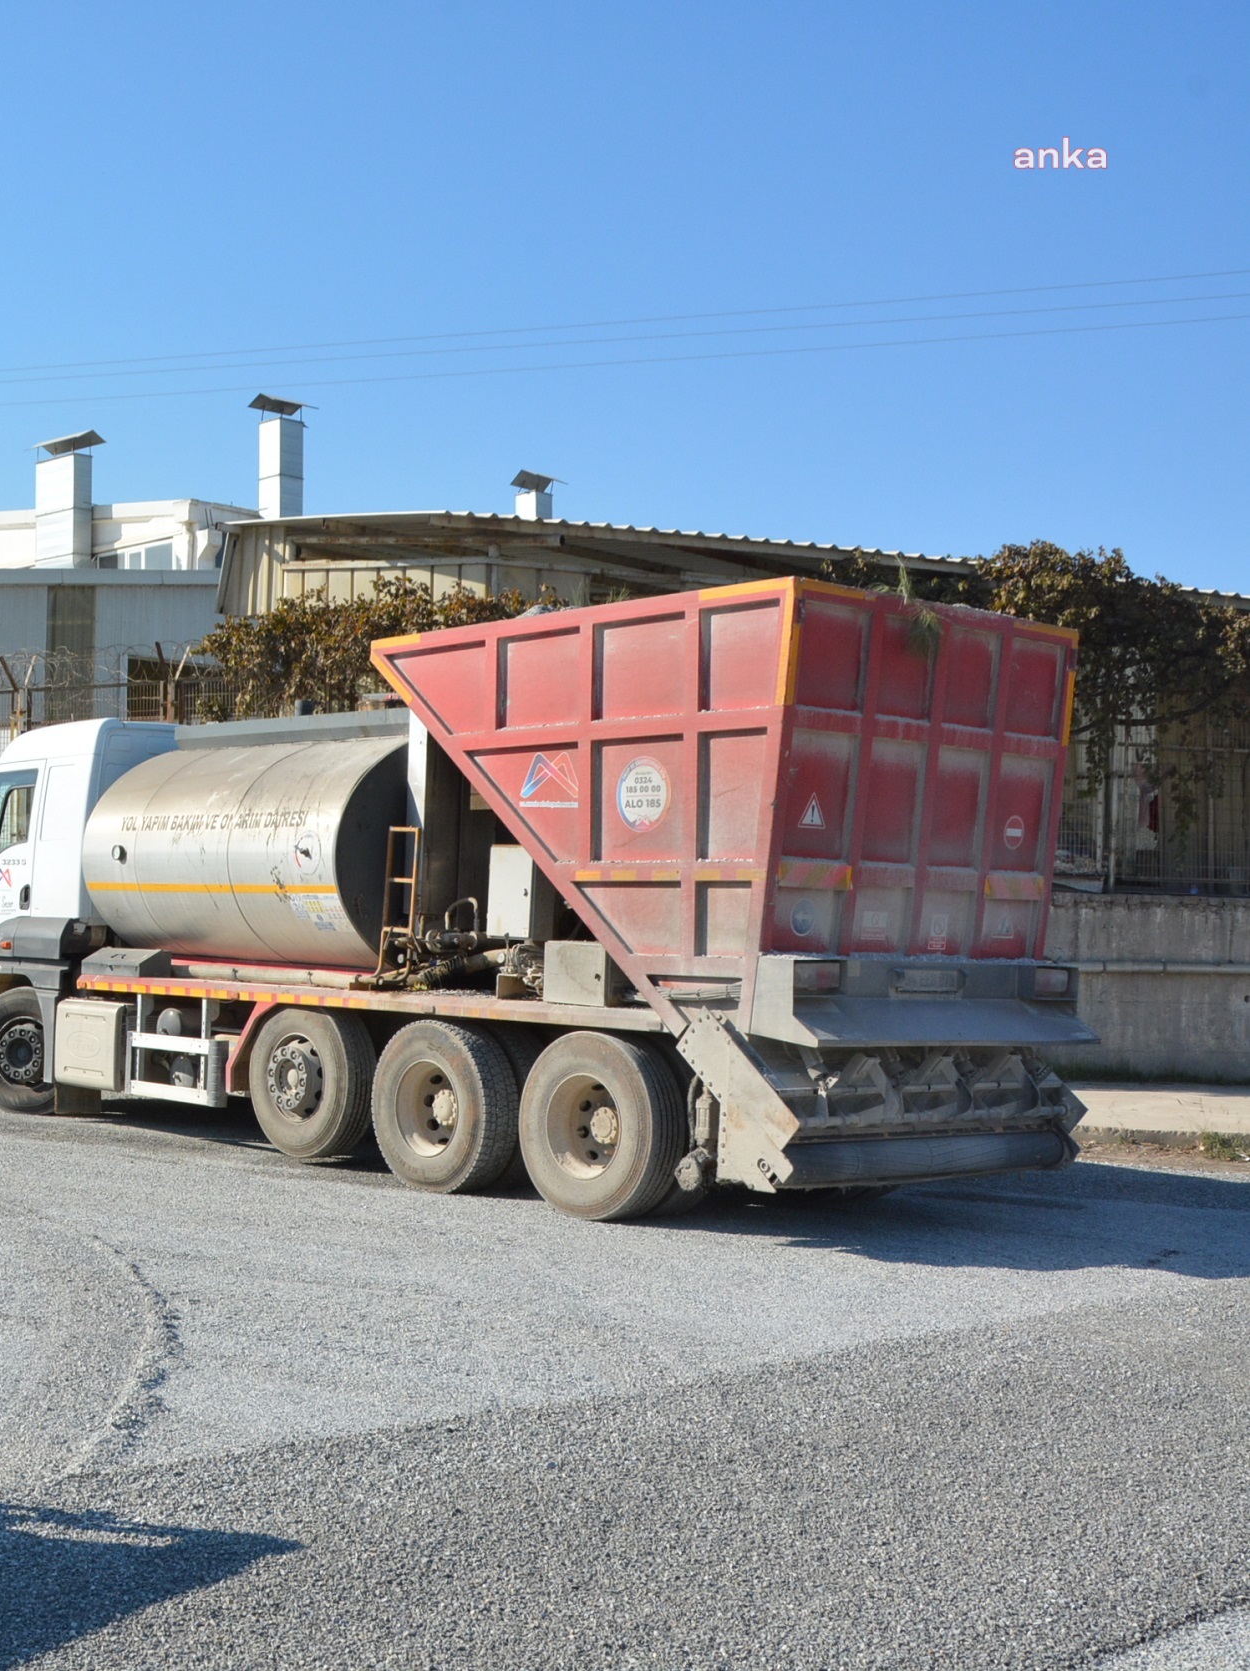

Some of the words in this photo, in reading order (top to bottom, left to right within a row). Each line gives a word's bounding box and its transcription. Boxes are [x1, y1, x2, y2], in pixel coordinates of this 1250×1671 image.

[634, 776, 653, 784] 0324
[639, 785, 649, 793] 00
[651, 785, 661, 793] 00
[624, 799, 643, 808] ALO
[646, 799, 661, 808] 185
[121, 816, 138, 832] YOL
[141, 815, 171, 832] YAPIM
[205, 814, 220, 831] VE
